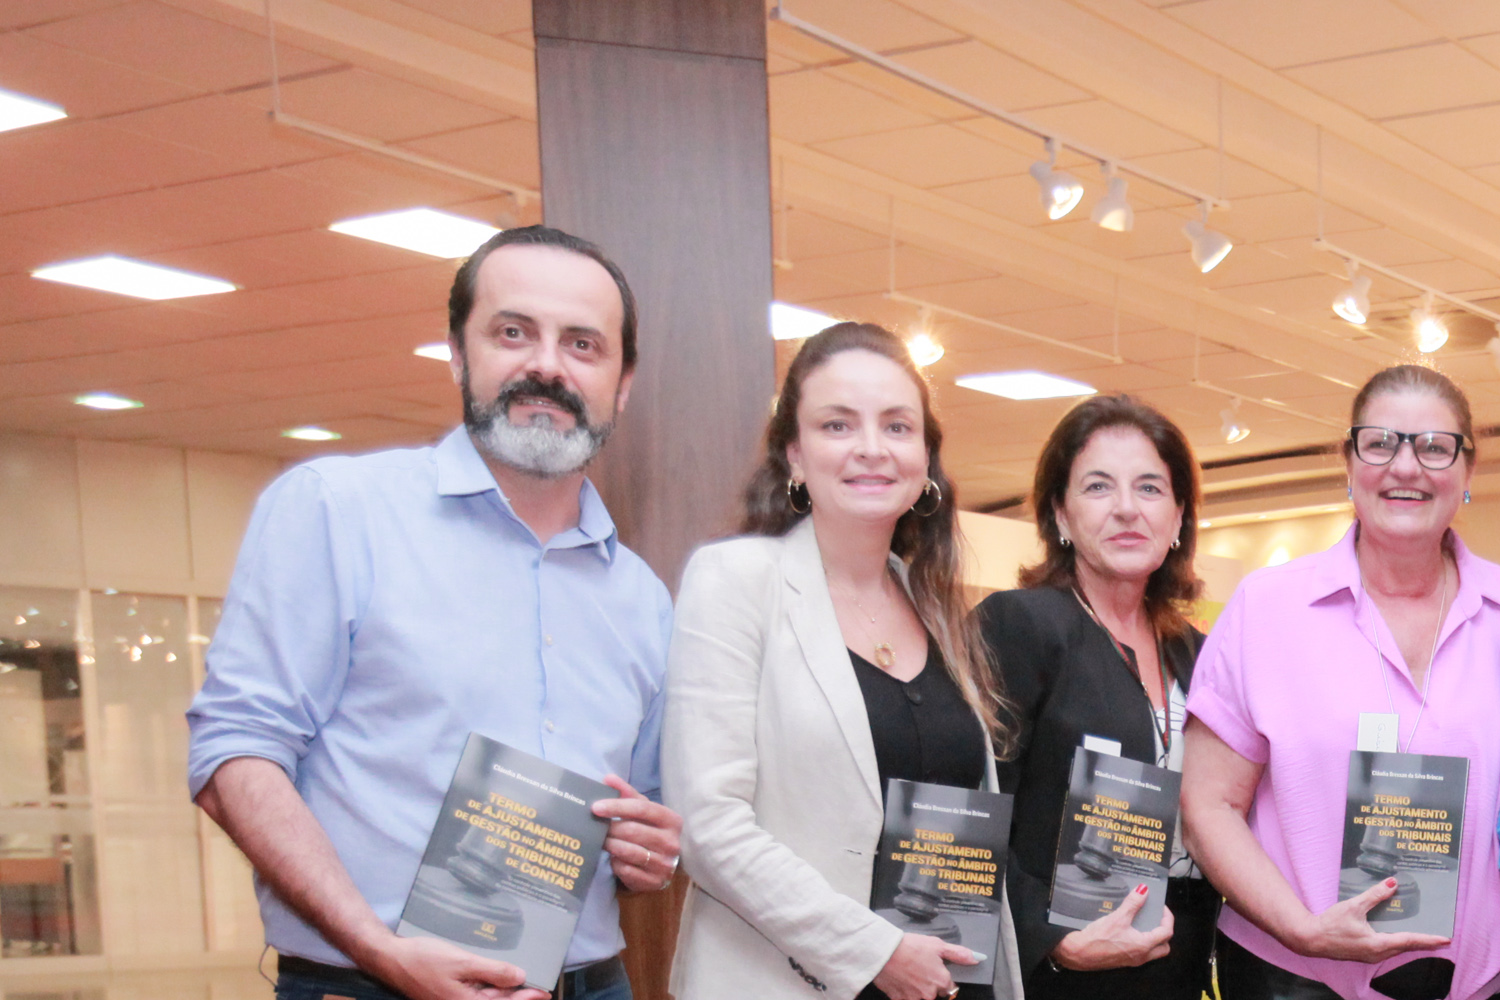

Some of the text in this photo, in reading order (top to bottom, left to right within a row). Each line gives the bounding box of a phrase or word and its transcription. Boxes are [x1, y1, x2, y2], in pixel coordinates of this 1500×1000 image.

[490, 792, 537, 819] TERMO
[1096, 795, 1129, 810] TERMO
[1375, 794, 1411, 805] TERMO
[1082, 804, 1162, 829] DE AJUSTAMENTO
[1373, 806, 1447, 819] AJUSTAMENTO
[468, 800, 581, 850] DE AJUSTAMENTO
[1074, 814, 1084, 822] DE
[1085, 816, 1120, 831] GESTÃO
[1132, 825, 1167, 842] ÂMBITO
[1365, 817, 1403, 828] GESTÃO
[1415, 819, 1453, 831] ÂMBITO
[455, 810, 469, 821] DE
[470, 815, 520, 842] GESTÃO
[535, 839, 585, 866] ÂMBITO
[916, 829, 954, 843] TERMO
[1114, 833, 1165, 852] TRIBUNAIS
[1397, 830, 1452, 842] TRIBUNAIS
[901, 841, 992, 859] DE AJUSTAMENTO
[1113, 845, 1162, 863] DE CONTAS
[1408, 842, 1450, 853] CONTAS
[509, 843, 581, 879] TRIBUNAIS
[892, 853, 903, 861] DE
[904, 854, 945, 867] GESTÃO
[958, 858, 997, 872] ÂMBITO
[506, 857, 575, 890] DE CONTAS
[939, 869, 996, 884] TRIBUNAIS
[950, 883, 993, 896] CONTAS
